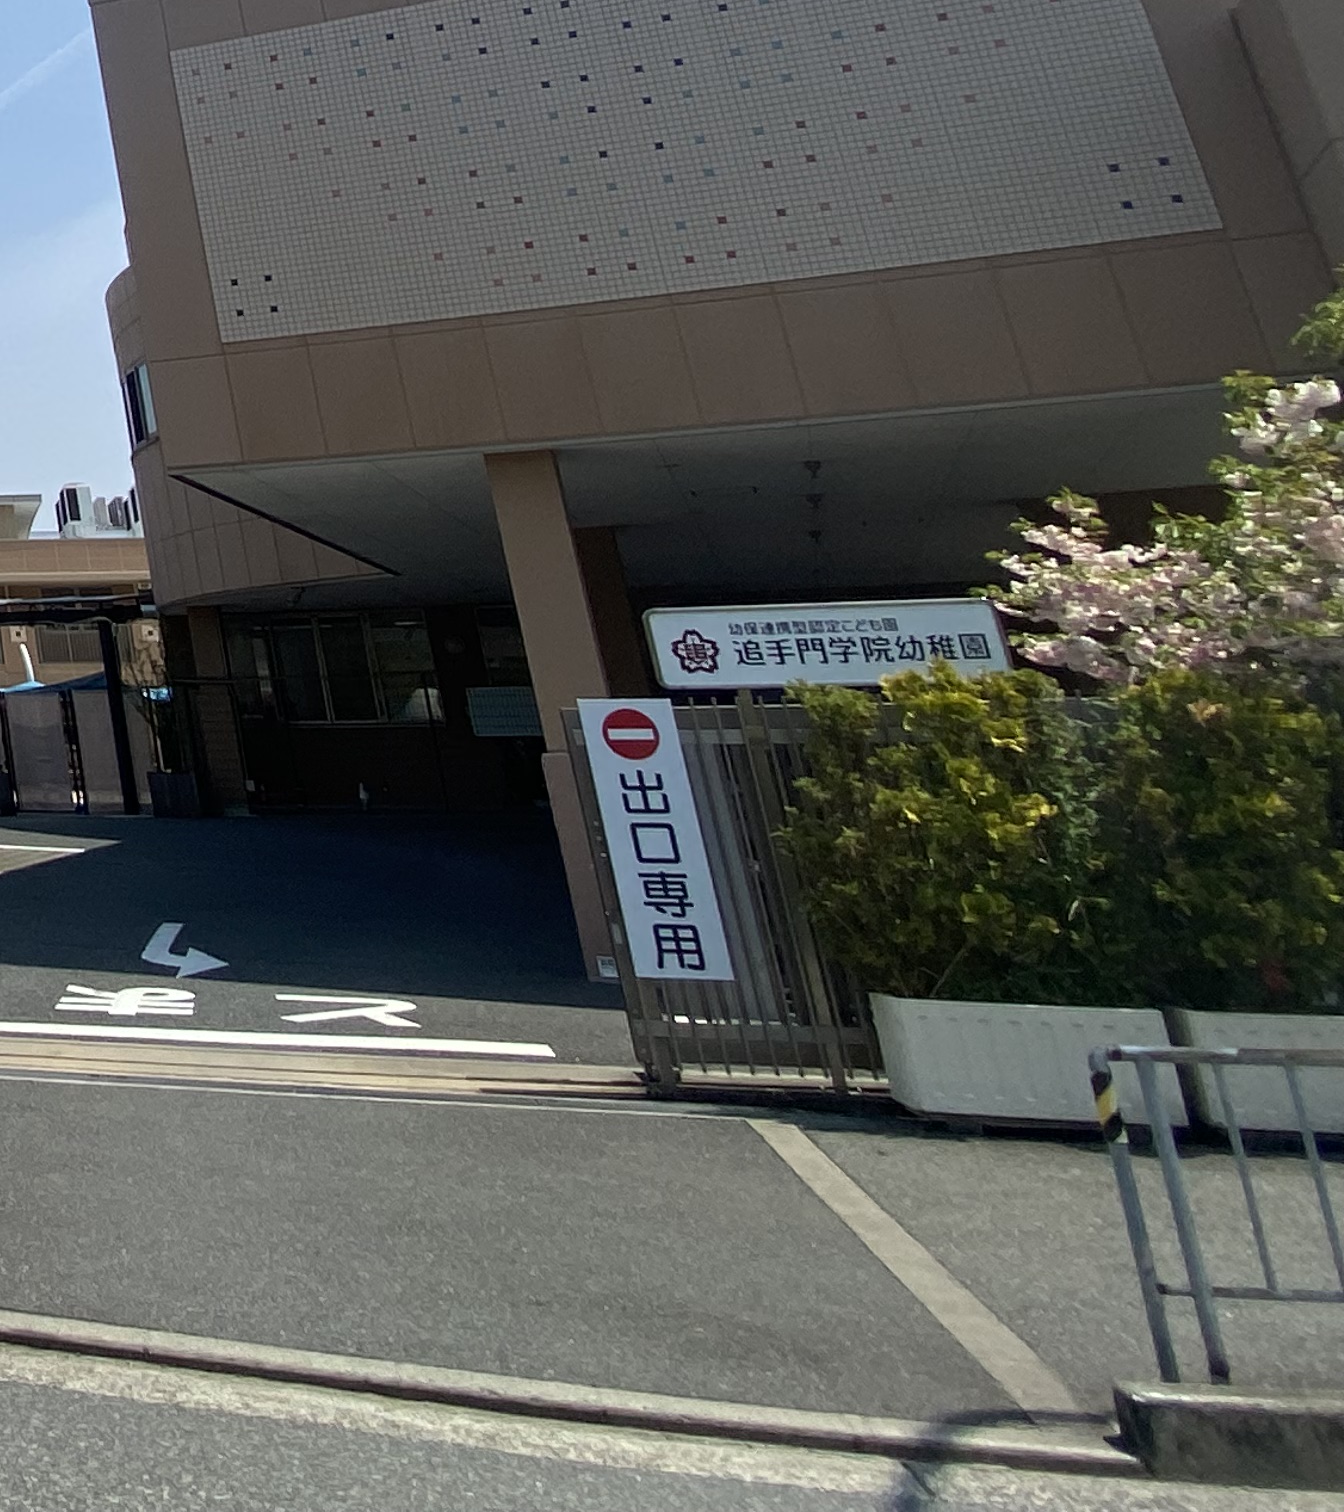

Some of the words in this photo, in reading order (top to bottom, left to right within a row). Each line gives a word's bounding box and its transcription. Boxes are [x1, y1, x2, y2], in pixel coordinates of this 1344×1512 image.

[728, 617, 899, 636] 幼保連携型認定こども園
[734, 633, 992, 666] 追手門学院幼稚園
[619, 769, 707, 972] 出口専用
